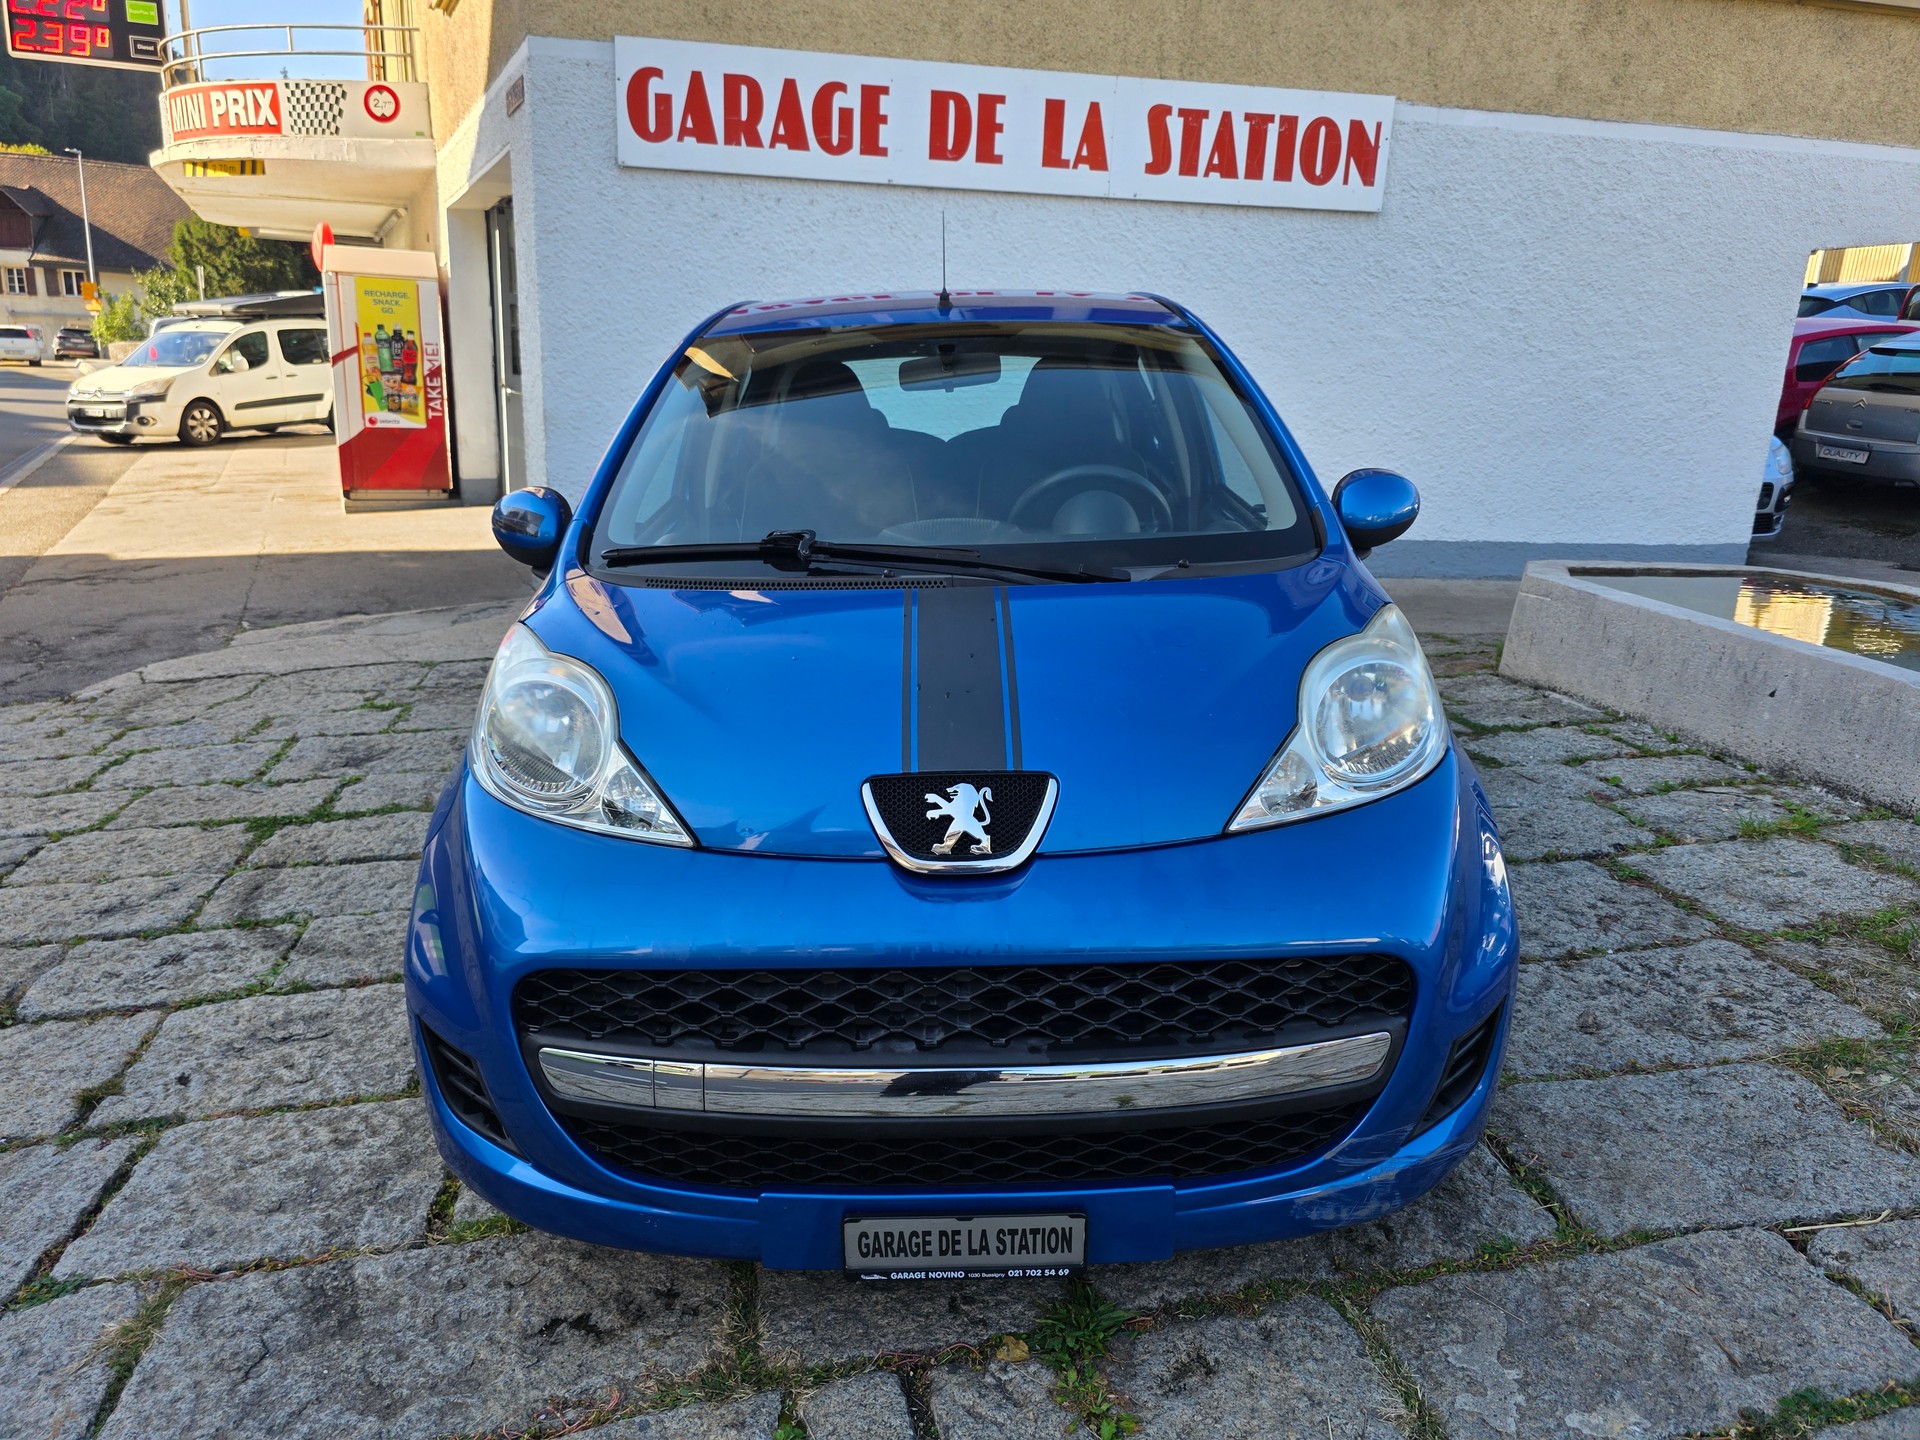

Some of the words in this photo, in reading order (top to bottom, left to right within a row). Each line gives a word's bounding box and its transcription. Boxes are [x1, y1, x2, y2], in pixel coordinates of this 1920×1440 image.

[137, 43, 155, 51] Diesel
[170, 92, 207, 134] MINI
[209, 88, 279, 128] PRIX
[626, 66, 890, 158] GARAGE
[929, 89, 1006, 165] DE
[1042, 98, 1109, 172] LA
[1145, 103, 1383, 187] STATION
[425, 342, 440, 374] ME!
[426, 376, 443, 420] TAKE
[858, 1230, 932, 1259] GARAGE
[938, 1230, 962, 1257] DE
[968, 1228, 990, 1256] LA
[996, 1227, 1073, 1256] STATION
[890, 1271, 926, 1280] GARAGE
[928, 1270, 965, 1279] NOVINO
[981, 1271, 1006, 1279] Bussigny
[1008, 1269, 1023, 1278] 021
[1025, 1269, 1042, 1278] 702
[1044, 1268, 1056, 1277] 54
[1058, 1267, 1070, 1277] 69
